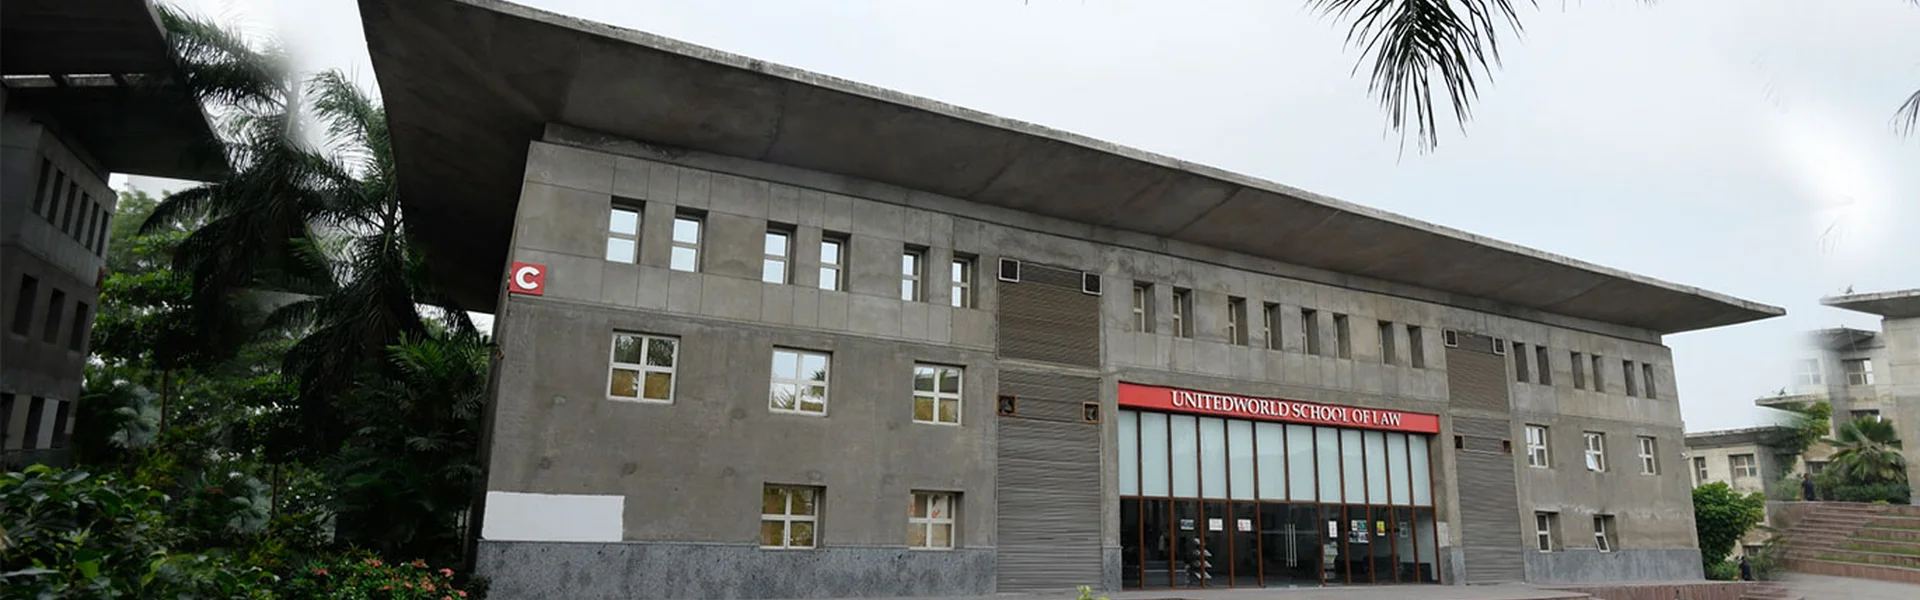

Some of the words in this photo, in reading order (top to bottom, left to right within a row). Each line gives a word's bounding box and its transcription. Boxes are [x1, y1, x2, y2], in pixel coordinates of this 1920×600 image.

[515, 266, 540, 290] C
[1171, 390, 1289, 417] UNITEDWORLD
[1292, 403, 1350, 423] SCHOOL
[1352, 409, 1370, 424] OF
[1373, 410, 1401, 427] LAW
